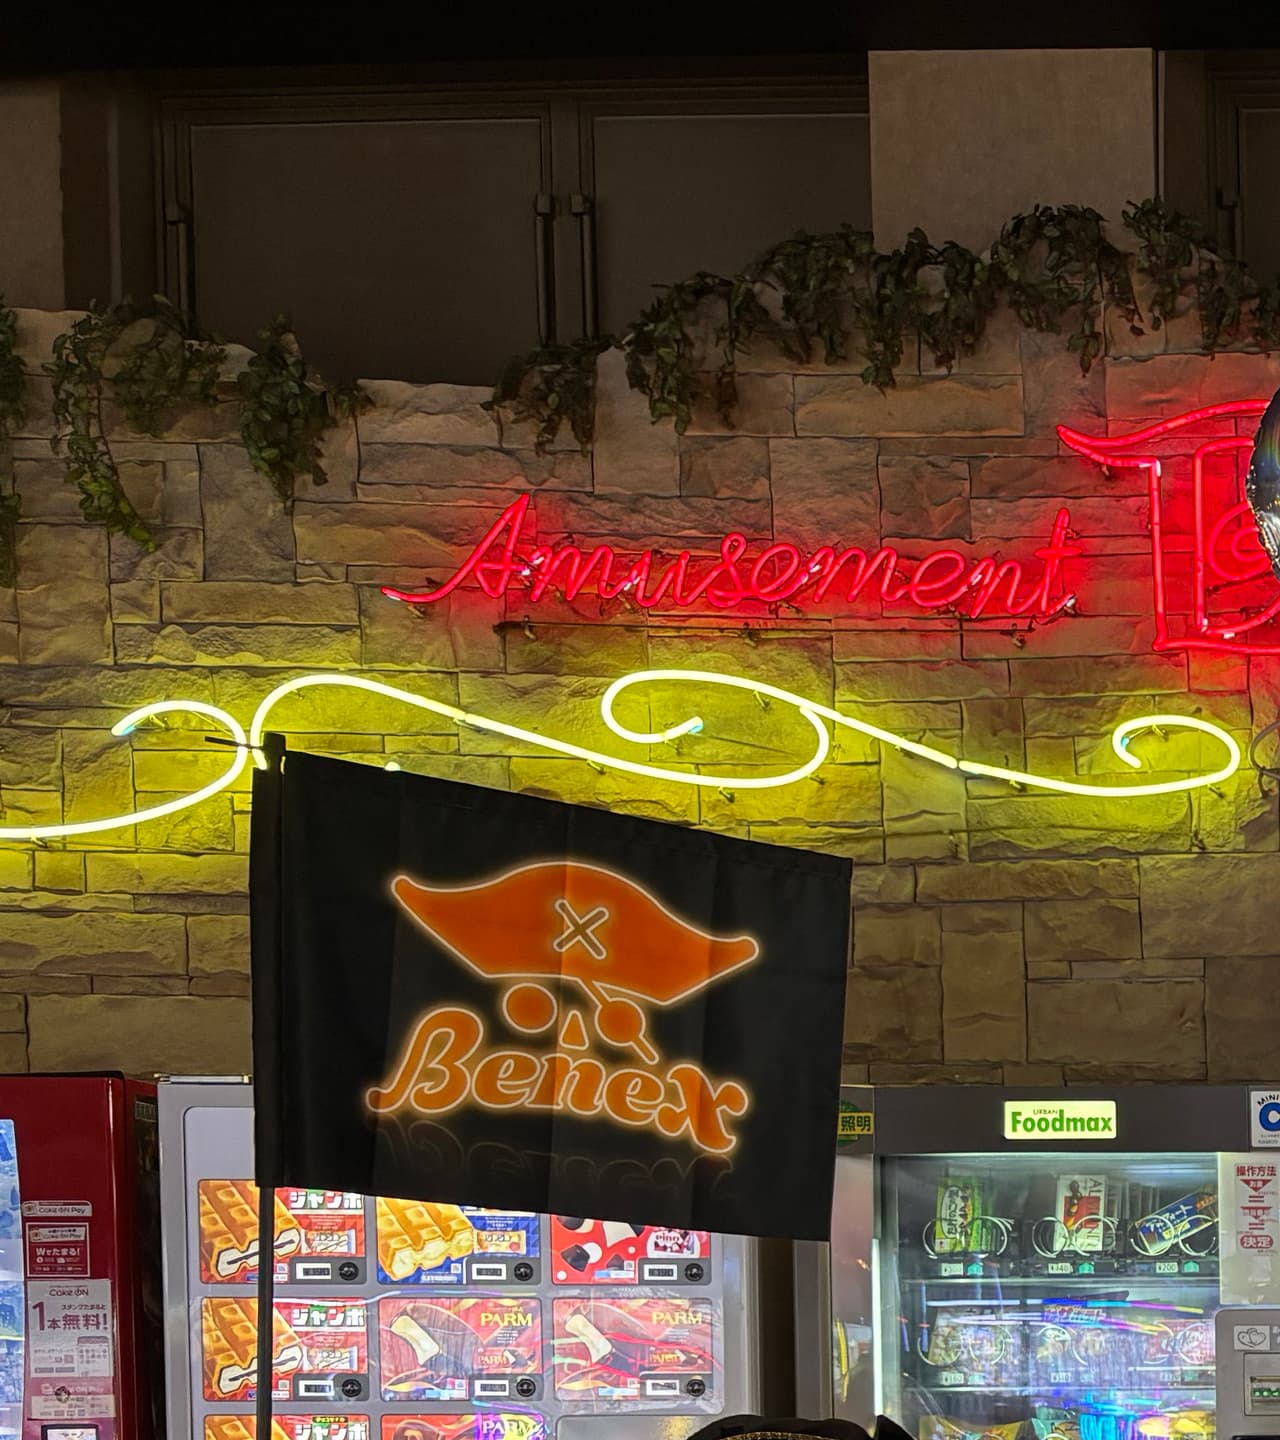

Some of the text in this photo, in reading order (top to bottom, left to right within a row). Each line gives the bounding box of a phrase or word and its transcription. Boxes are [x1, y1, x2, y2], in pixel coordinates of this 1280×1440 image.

[382, 494, 1080, 617] Amusement
[365, 1005, 749, 1153] Benex
[1257, 1093, 1280, 1106] MINI
[840, 1115, 872, 1132] 照明
[1010, 1110, 1113, 1133] Foodmax
[1236, 1165, 1277, 1177] 操作方法
[289, 1190, 365, 1210] ジャンボ
[32, 1301, 108, 1331] 1本無料!
[292, 1308, 367, 1327] ジャンボ
[480, 1311, 533, 1327] PARM
[651, 1311, 703, 1326] PARM
